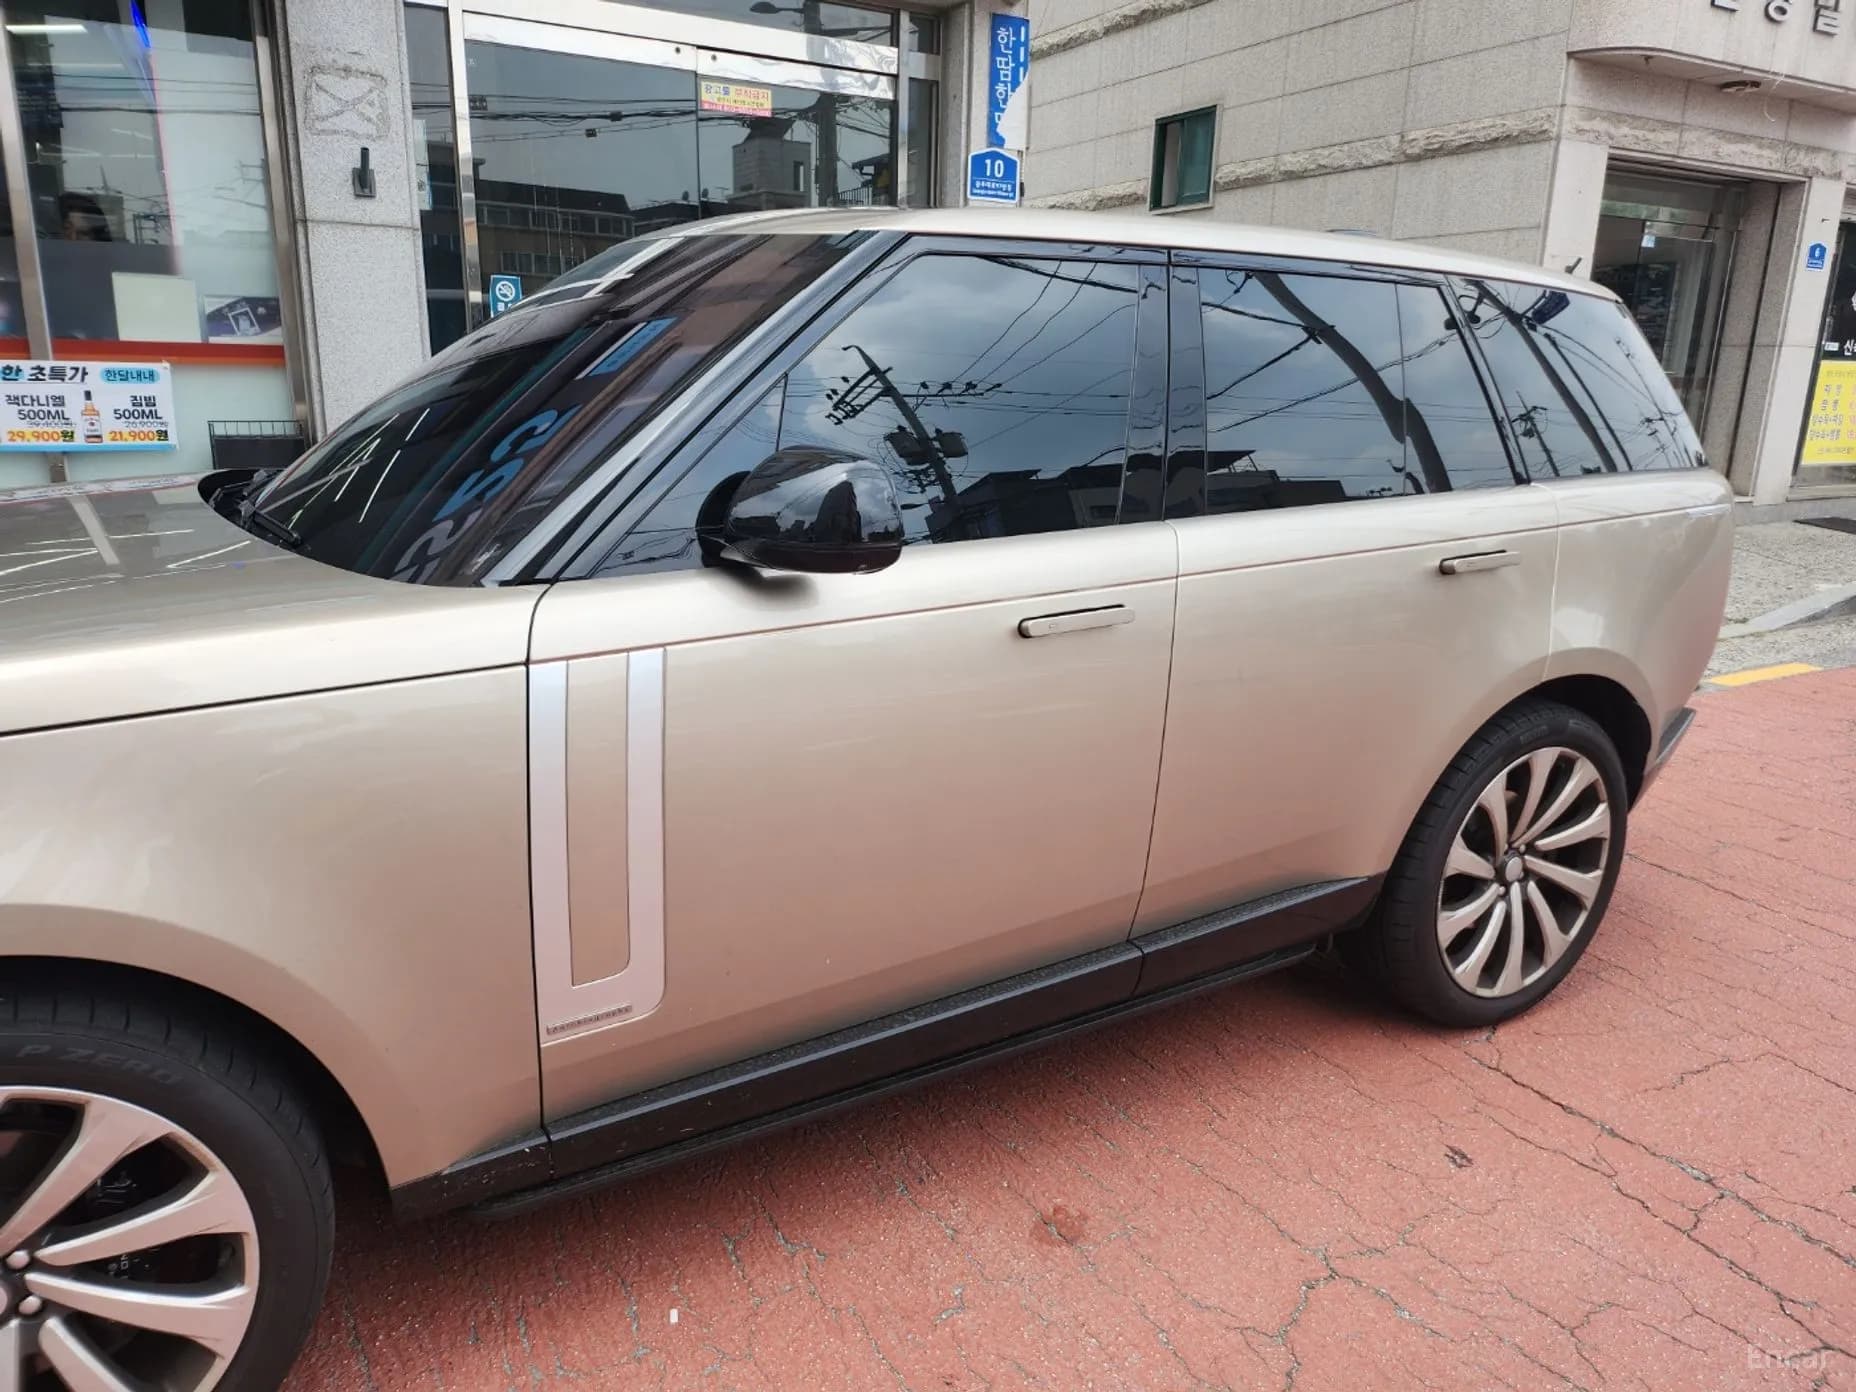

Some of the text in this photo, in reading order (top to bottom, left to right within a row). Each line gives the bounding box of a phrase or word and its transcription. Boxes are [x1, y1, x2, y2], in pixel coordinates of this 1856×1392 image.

[984, 159, 1005, 178] 10
[27, 364, 89, 383] 초특가
[104, 369, 156, 382] 한달내내
[5, 394, 66, 407] 잭다니엘
[129, 395, 157, 407] 짐빔
[17, 409, 70, 421] 500ML
[113, 409, 163, 420] 500ML
